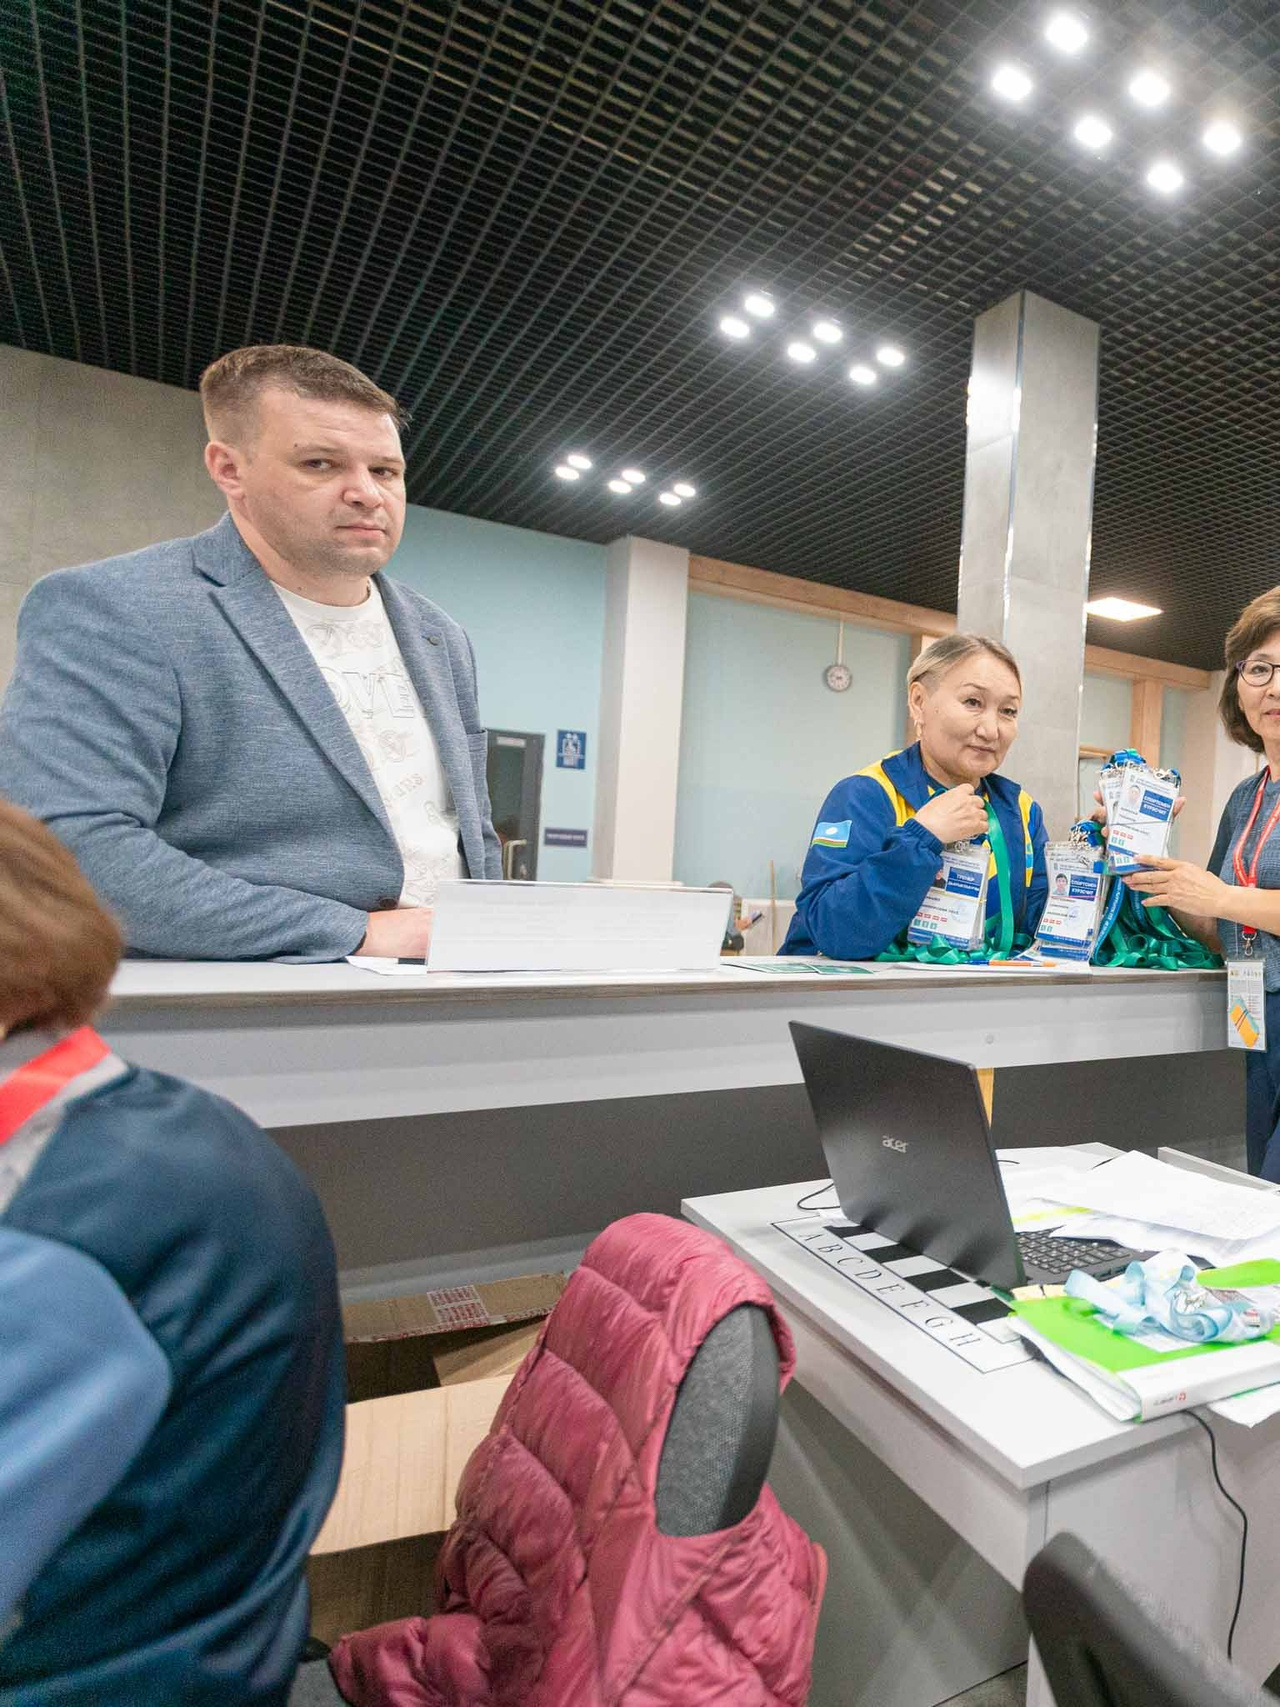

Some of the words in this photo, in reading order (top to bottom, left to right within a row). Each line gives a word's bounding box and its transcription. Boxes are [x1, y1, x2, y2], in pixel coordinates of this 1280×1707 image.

[882, 1135, 908, 1153] acer
[798, 1232, 821, 1242] A
[817, 1244, 840, 1253] B
[836, 1257, 863, 1267] C
[855, 1270, 882, 1280] D
[876, 1283, 906, 1295] E
[901, 1300, 931, 1310] F
[924, 1316, 954, 1329] G
[949, 1333, 982, 1347] H
